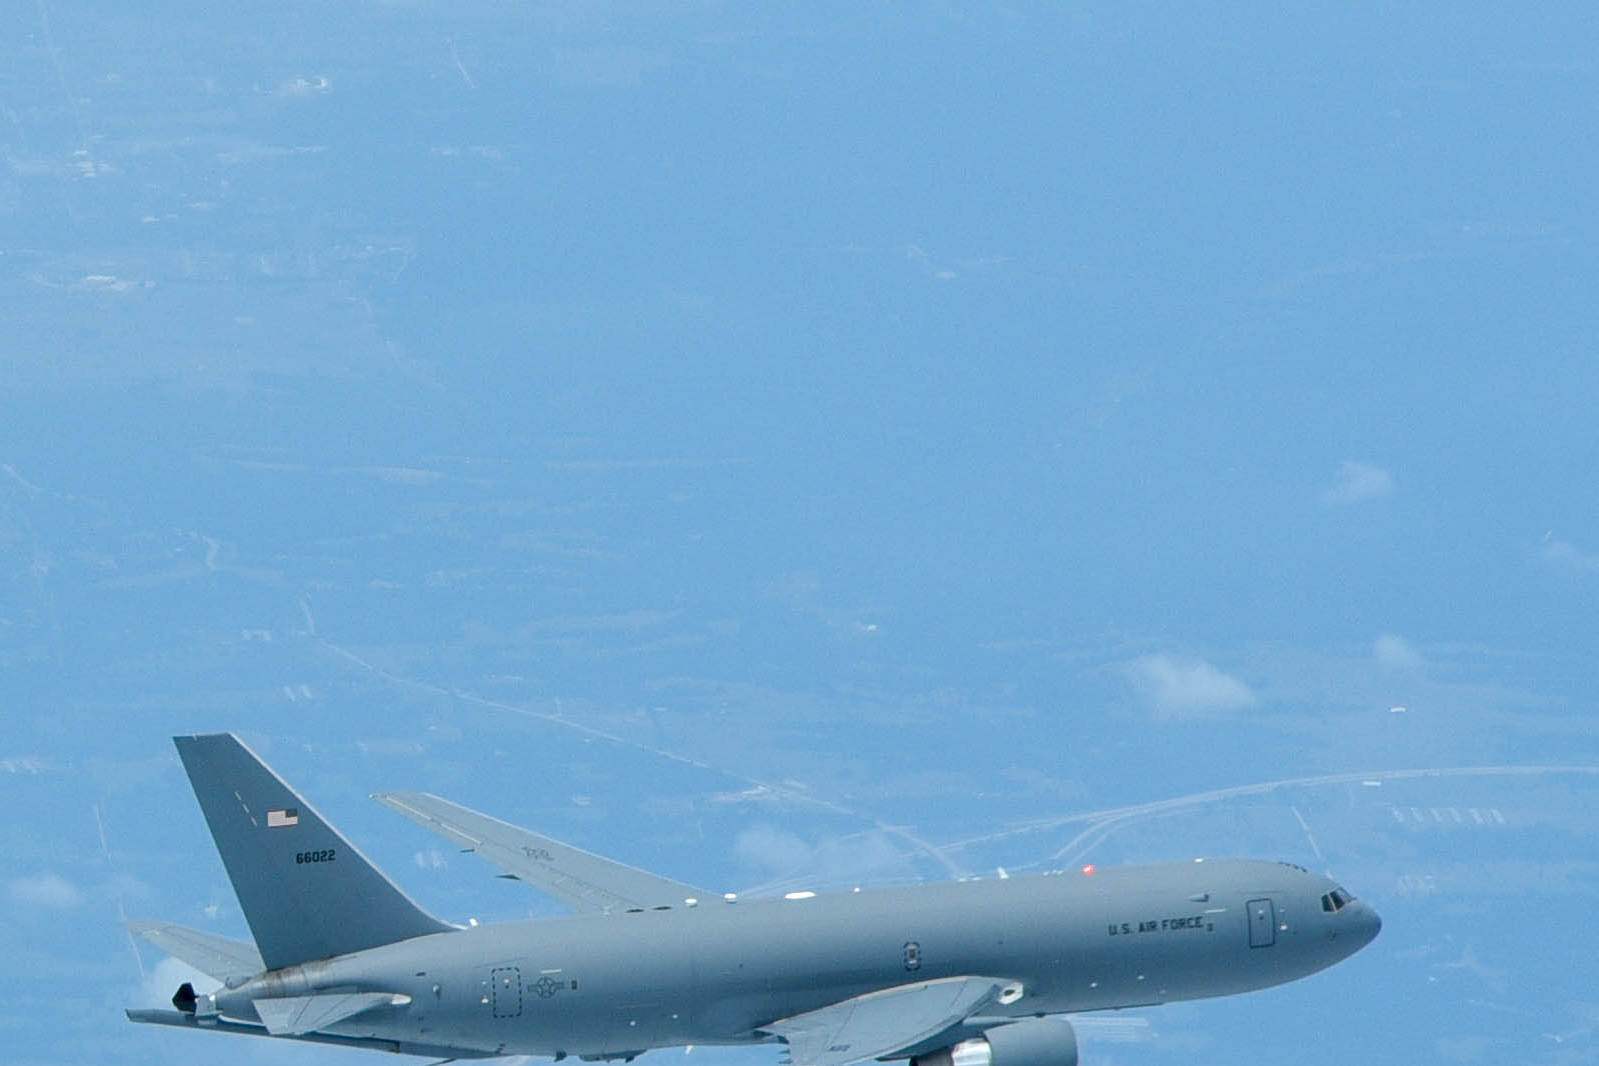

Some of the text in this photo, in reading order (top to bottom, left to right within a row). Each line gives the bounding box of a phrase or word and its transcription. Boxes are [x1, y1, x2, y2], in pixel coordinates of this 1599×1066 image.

[296, 849, 336, 864] 66022
[1108, 916, 1204, 936] U.S. AIR FORCE
